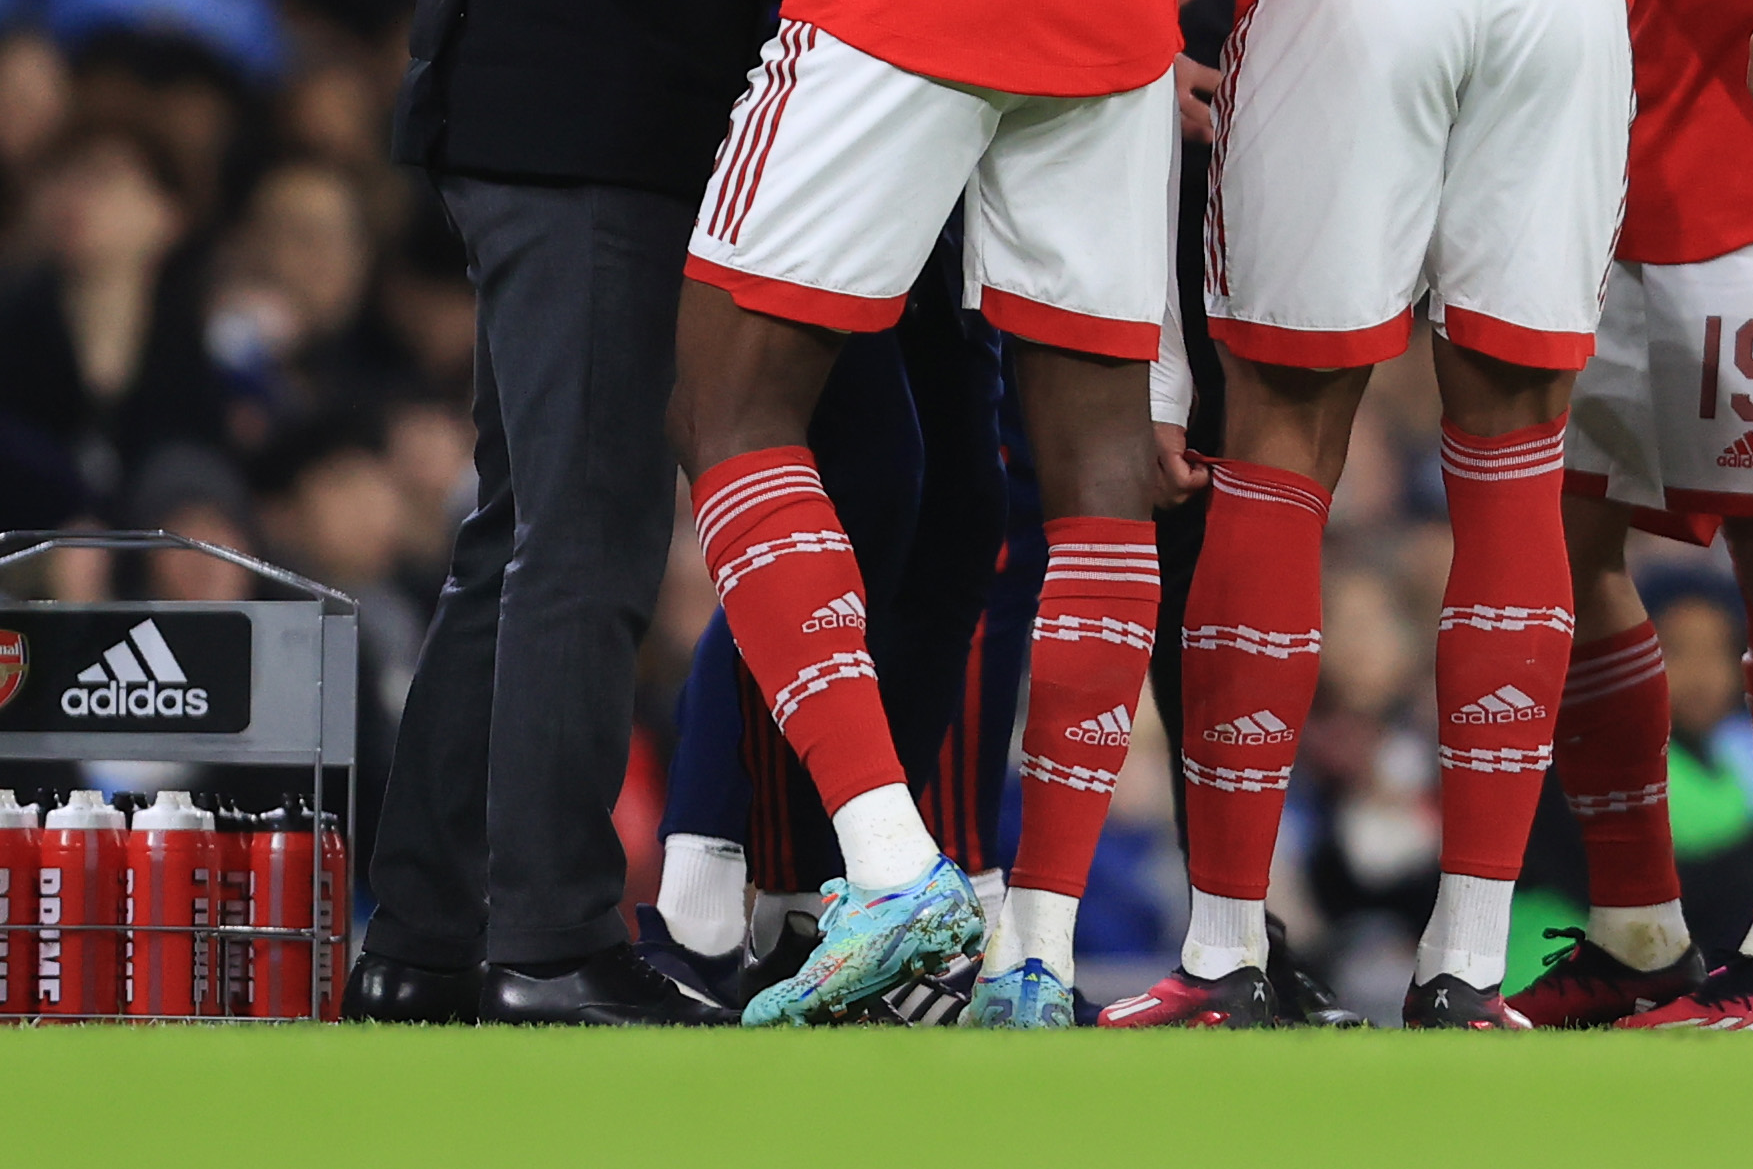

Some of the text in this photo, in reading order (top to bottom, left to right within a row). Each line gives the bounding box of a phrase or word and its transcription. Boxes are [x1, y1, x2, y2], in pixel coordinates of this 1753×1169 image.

[802, 613, 867, 636] adida
[60, 680, 209, 717] adidas
[1451, 705, 1547, 725] adidas
[1065, 726, 1131, 747] adida
[1203, 729, 1295, 745] adidas
